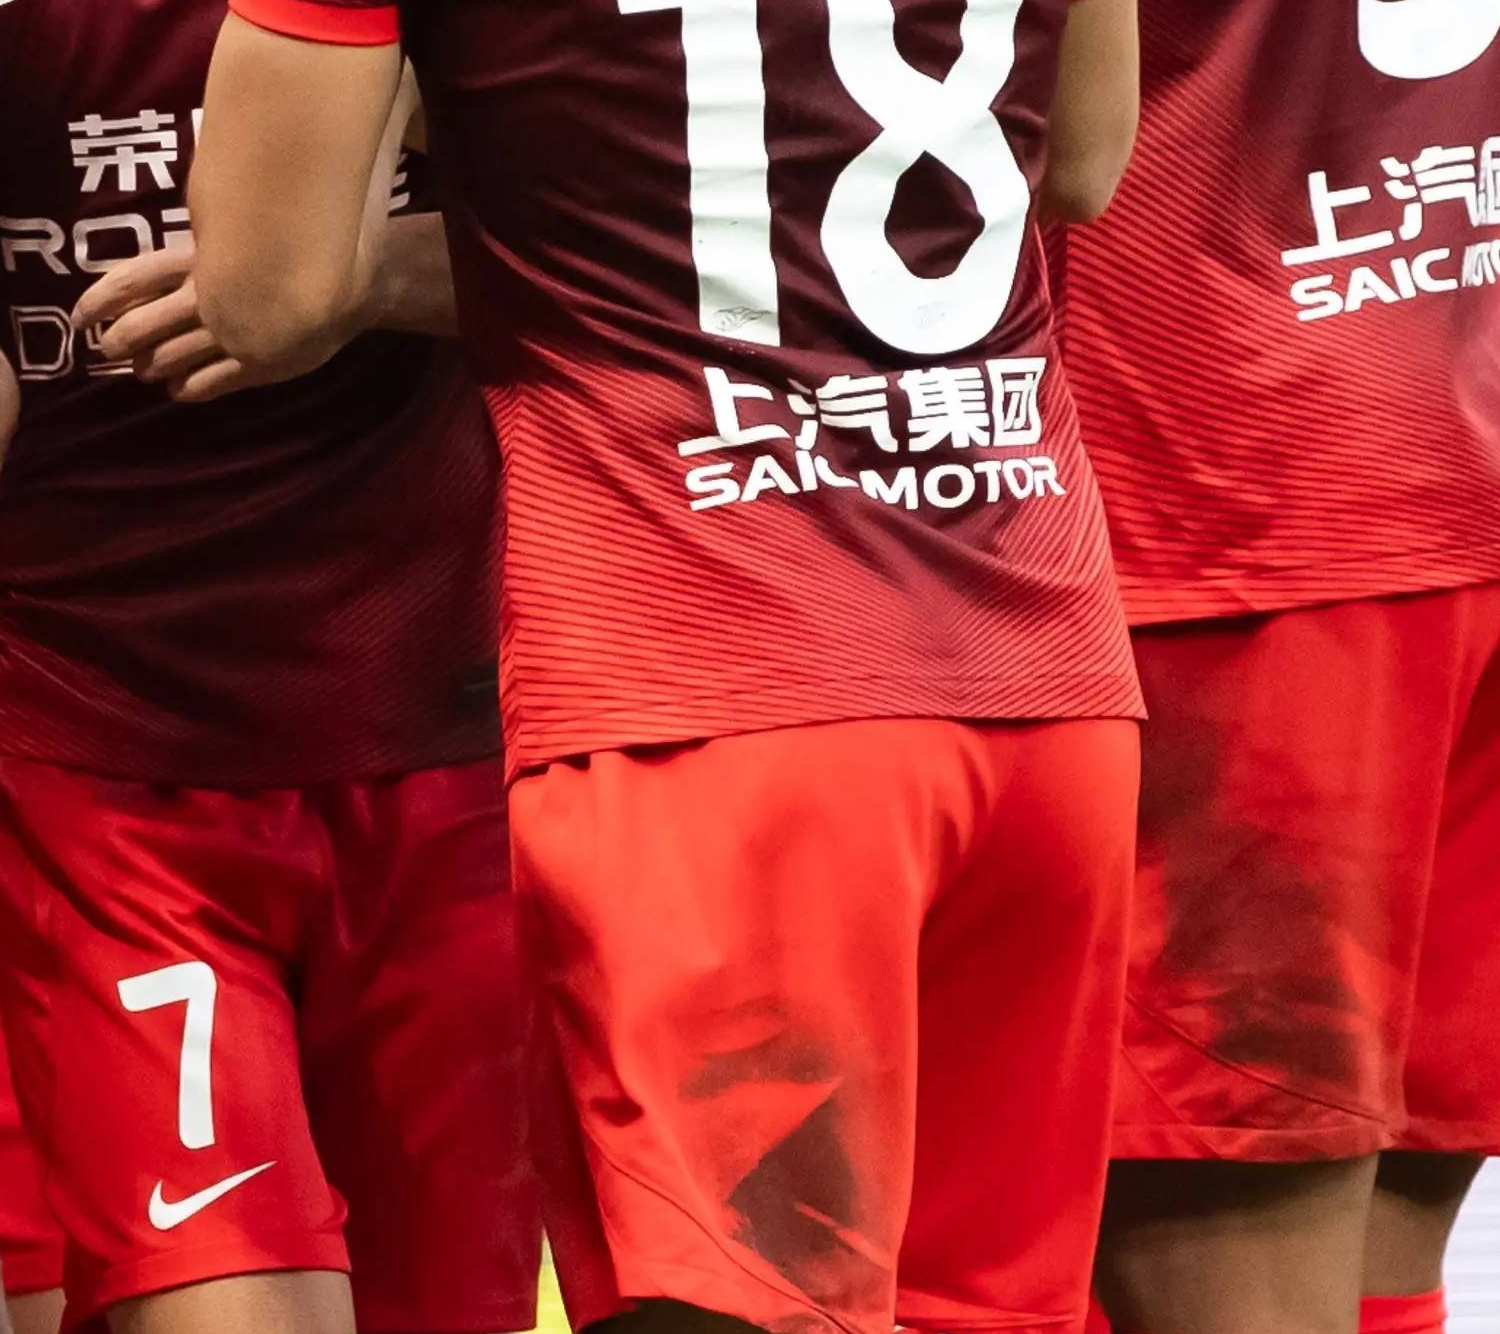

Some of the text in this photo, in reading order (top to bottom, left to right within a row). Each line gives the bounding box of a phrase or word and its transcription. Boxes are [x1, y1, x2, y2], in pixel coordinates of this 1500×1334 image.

[1290, 246, 1458, 323] SAIC
[677, 357, 1047, 457] 上汽集团
[858, 455, 1067, 511] MOTOR
[116, 960, 218, 1150] 7
